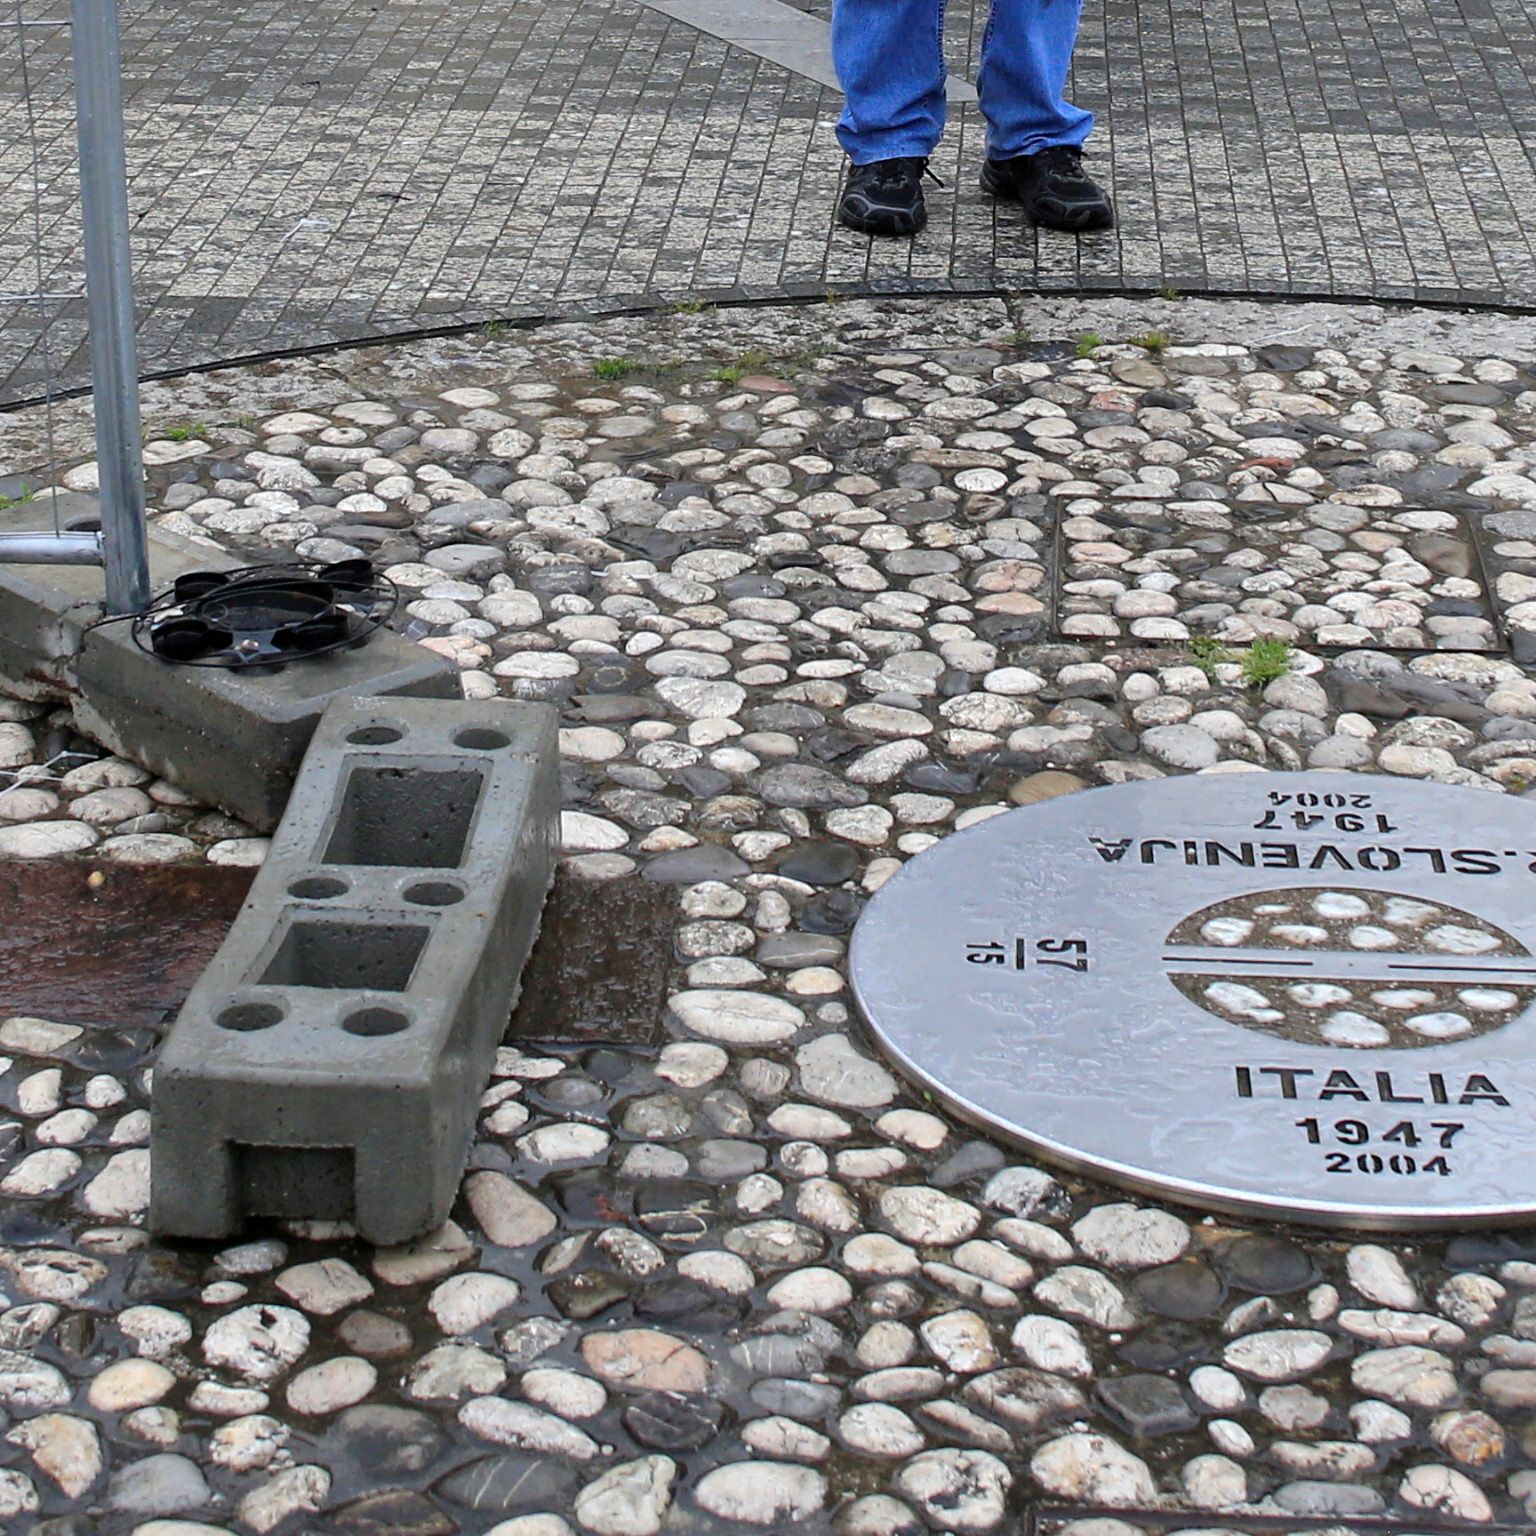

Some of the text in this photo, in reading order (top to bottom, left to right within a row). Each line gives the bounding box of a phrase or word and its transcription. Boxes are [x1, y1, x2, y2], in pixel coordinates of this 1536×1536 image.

[1267, 790, 1373, 809] 2004
[1253, 810, 1399, 834] 1947
[1235, 1066, 1511, 1107] ITALIA
[1295, 1117, 1464, 1149] 1947
[1324, 1152, 1452, 1176] 2004
